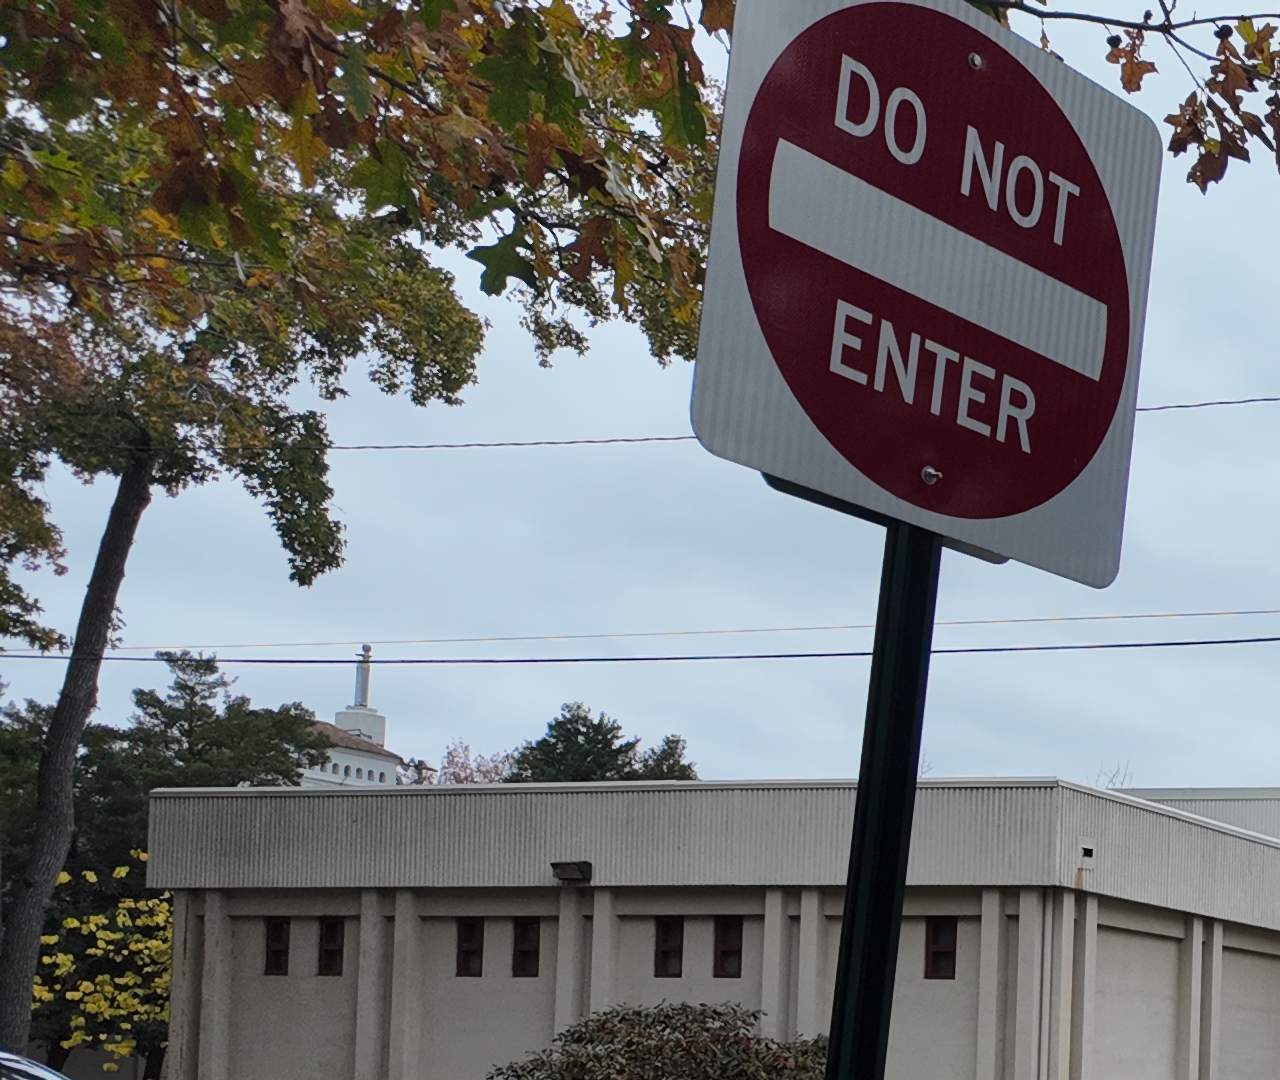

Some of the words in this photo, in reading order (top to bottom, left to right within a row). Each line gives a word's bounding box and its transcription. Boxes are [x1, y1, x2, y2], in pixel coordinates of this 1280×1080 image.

[834, 53, 927, 165] DO
[960, 125, 1080, 246] NOT
[829, 299, 1037, 454] ENTER
